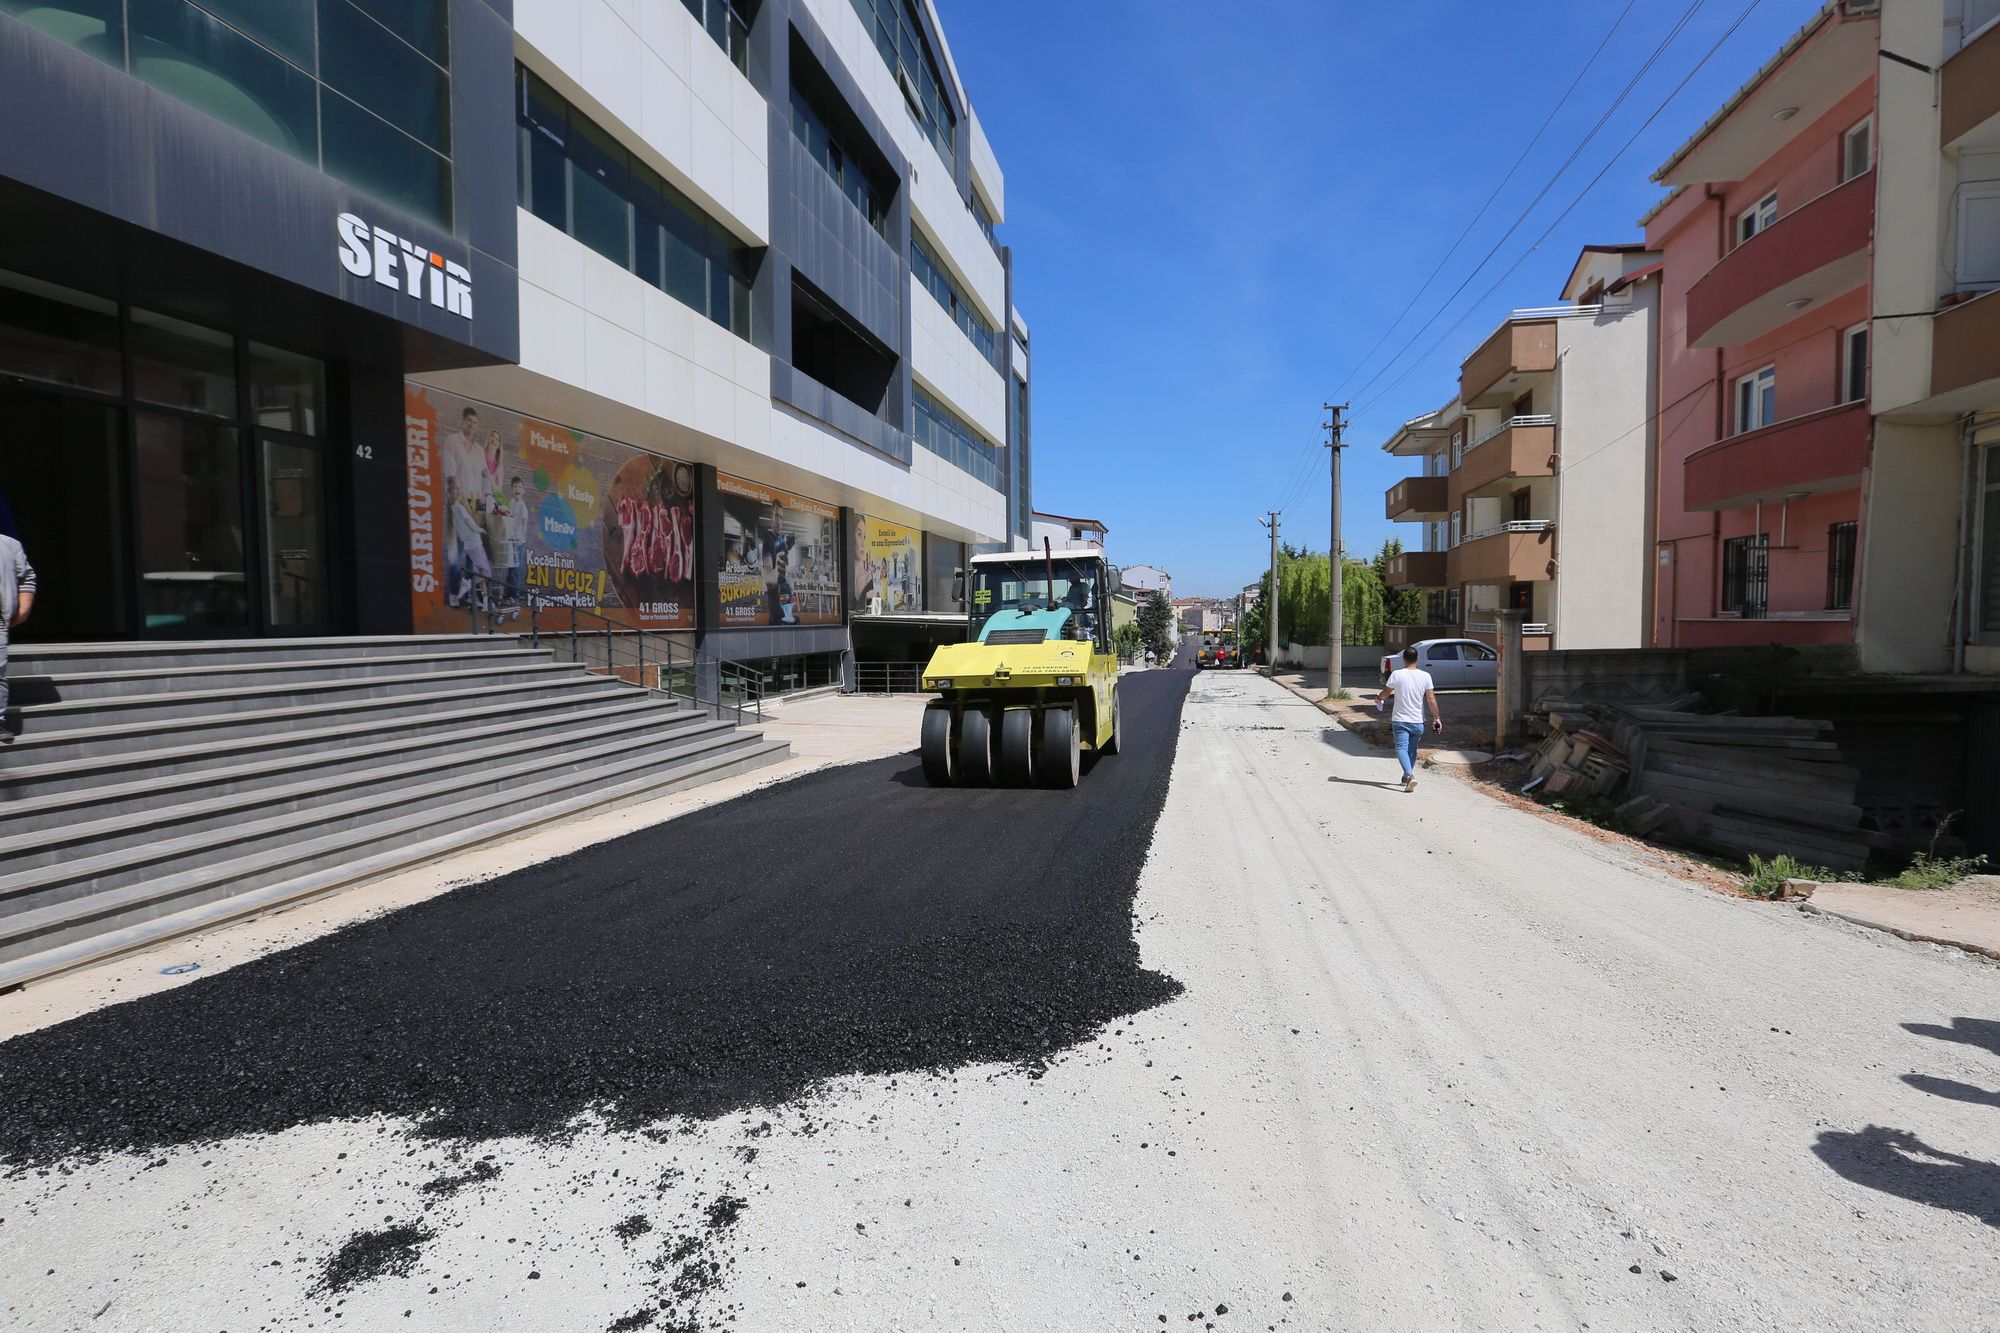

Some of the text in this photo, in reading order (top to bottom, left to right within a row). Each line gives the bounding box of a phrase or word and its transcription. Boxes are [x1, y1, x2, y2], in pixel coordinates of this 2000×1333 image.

[530, 430, 569, 455] Market
[356, 445, 373, 460] 42
[568, 484, 595, 509] Kasap
[544, 516, 575, 535] Manav
[527, 564, 549, 587] EN
[639, 601, 679, 613] 41 GROSS
[725, 606, 756, 616] 41 GROSS
